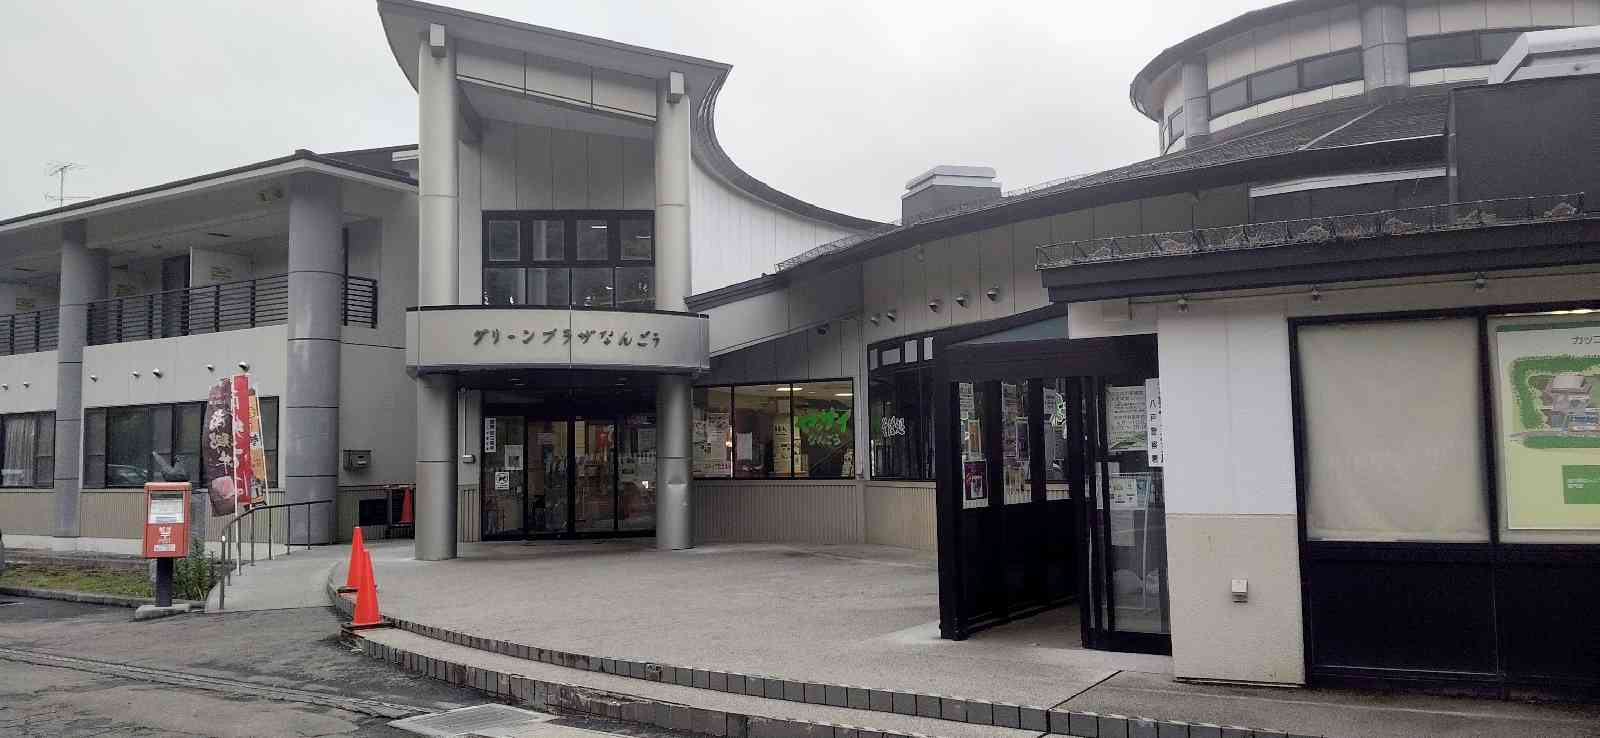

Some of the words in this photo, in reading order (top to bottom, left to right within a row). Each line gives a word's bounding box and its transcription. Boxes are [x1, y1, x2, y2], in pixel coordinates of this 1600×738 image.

[473, 328, 661, 348] グリーンプラザなんごう
